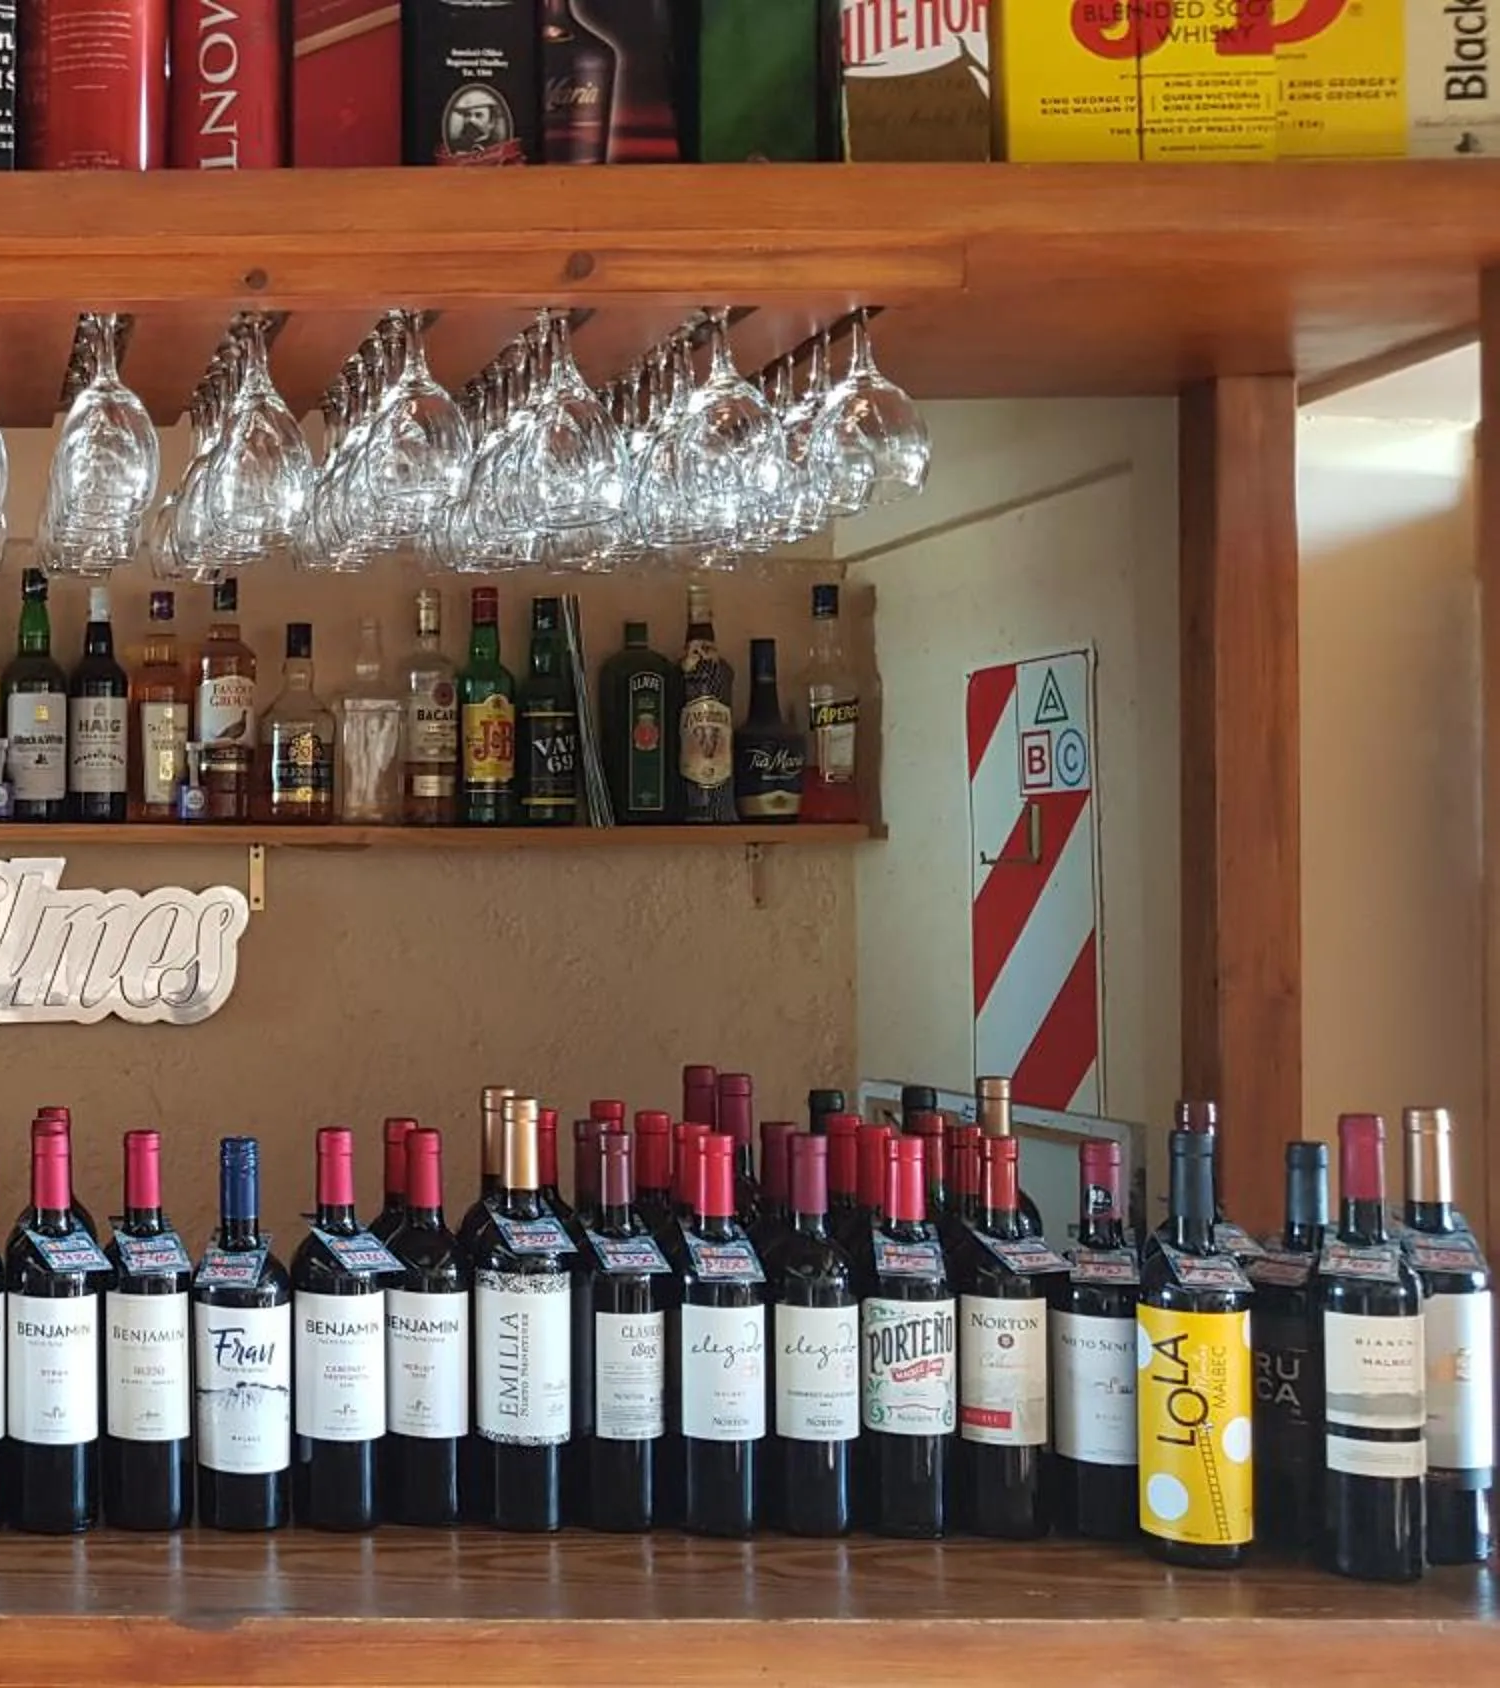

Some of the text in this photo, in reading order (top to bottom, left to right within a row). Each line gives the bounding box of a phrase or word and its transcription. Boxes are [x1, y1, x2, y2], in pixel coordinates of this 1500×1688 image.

[1042, 688, 1061, 714] A
[78, 719, 122, 733] HAIG
[1027, 743, 1068, 774] B C
[16, 1320, 91, 1338] BENJAMIN
[112, 1325, 184, 1344] BENJAMIN
[305, 1319, 380, 1337] BENJAMIN
[970, 1313, 1039, 1331] NORTON
[870, 1311, 953, 1376] PORTEÑO
[499, 1312, 520, 1418] EMILIA
[1212, 1344, 1227, 1410] MALBEC
[1151, 1333, 1209, 1448] LOLA
